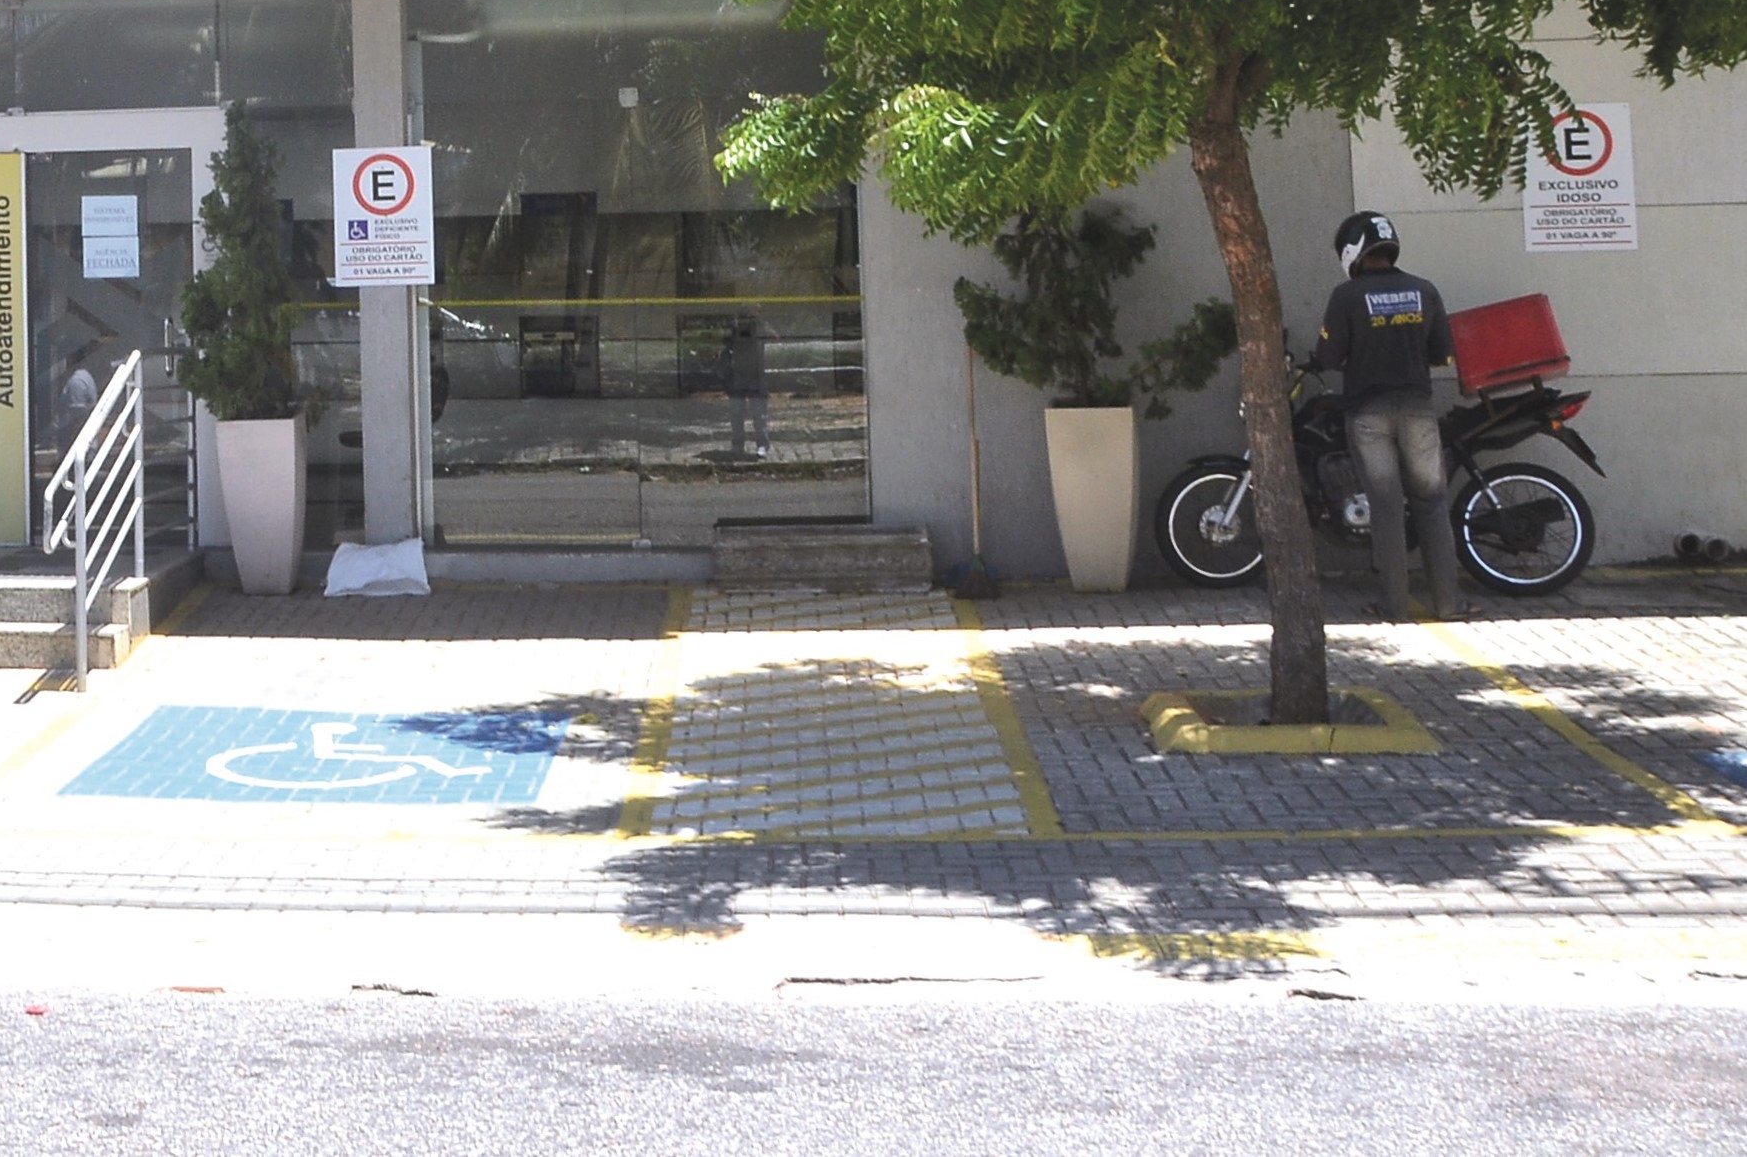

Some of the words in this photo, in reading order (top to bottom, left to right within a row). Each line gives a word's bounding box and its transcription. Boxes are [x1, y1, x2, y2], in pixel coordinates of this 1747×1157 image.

[1563, 127, 1592, 160] E
[372, 170, 396, 201] E
[1538, 179, 1619, 191] EXCLUSIVO
[1556, 192, 1602, 203] IDOSO
[1543, 206, 1617, 216] OBRIGATÓRIO
[1536, 218, 1559, 226] USO
[1561, 217, 1577, 225] DO
[1580, 215, 1624, 224] CARTÃO
[1560, 231, 1589, 239] VAGA
[352, 244, 416, 254] OBRIGATÓRIO
[368, 254, 381, 262] DO
[384, 253, 423, 261] CARTÃO
[366, 267, 392, 275] VAGA
[1369, 291, 1417, 304] WEBER
